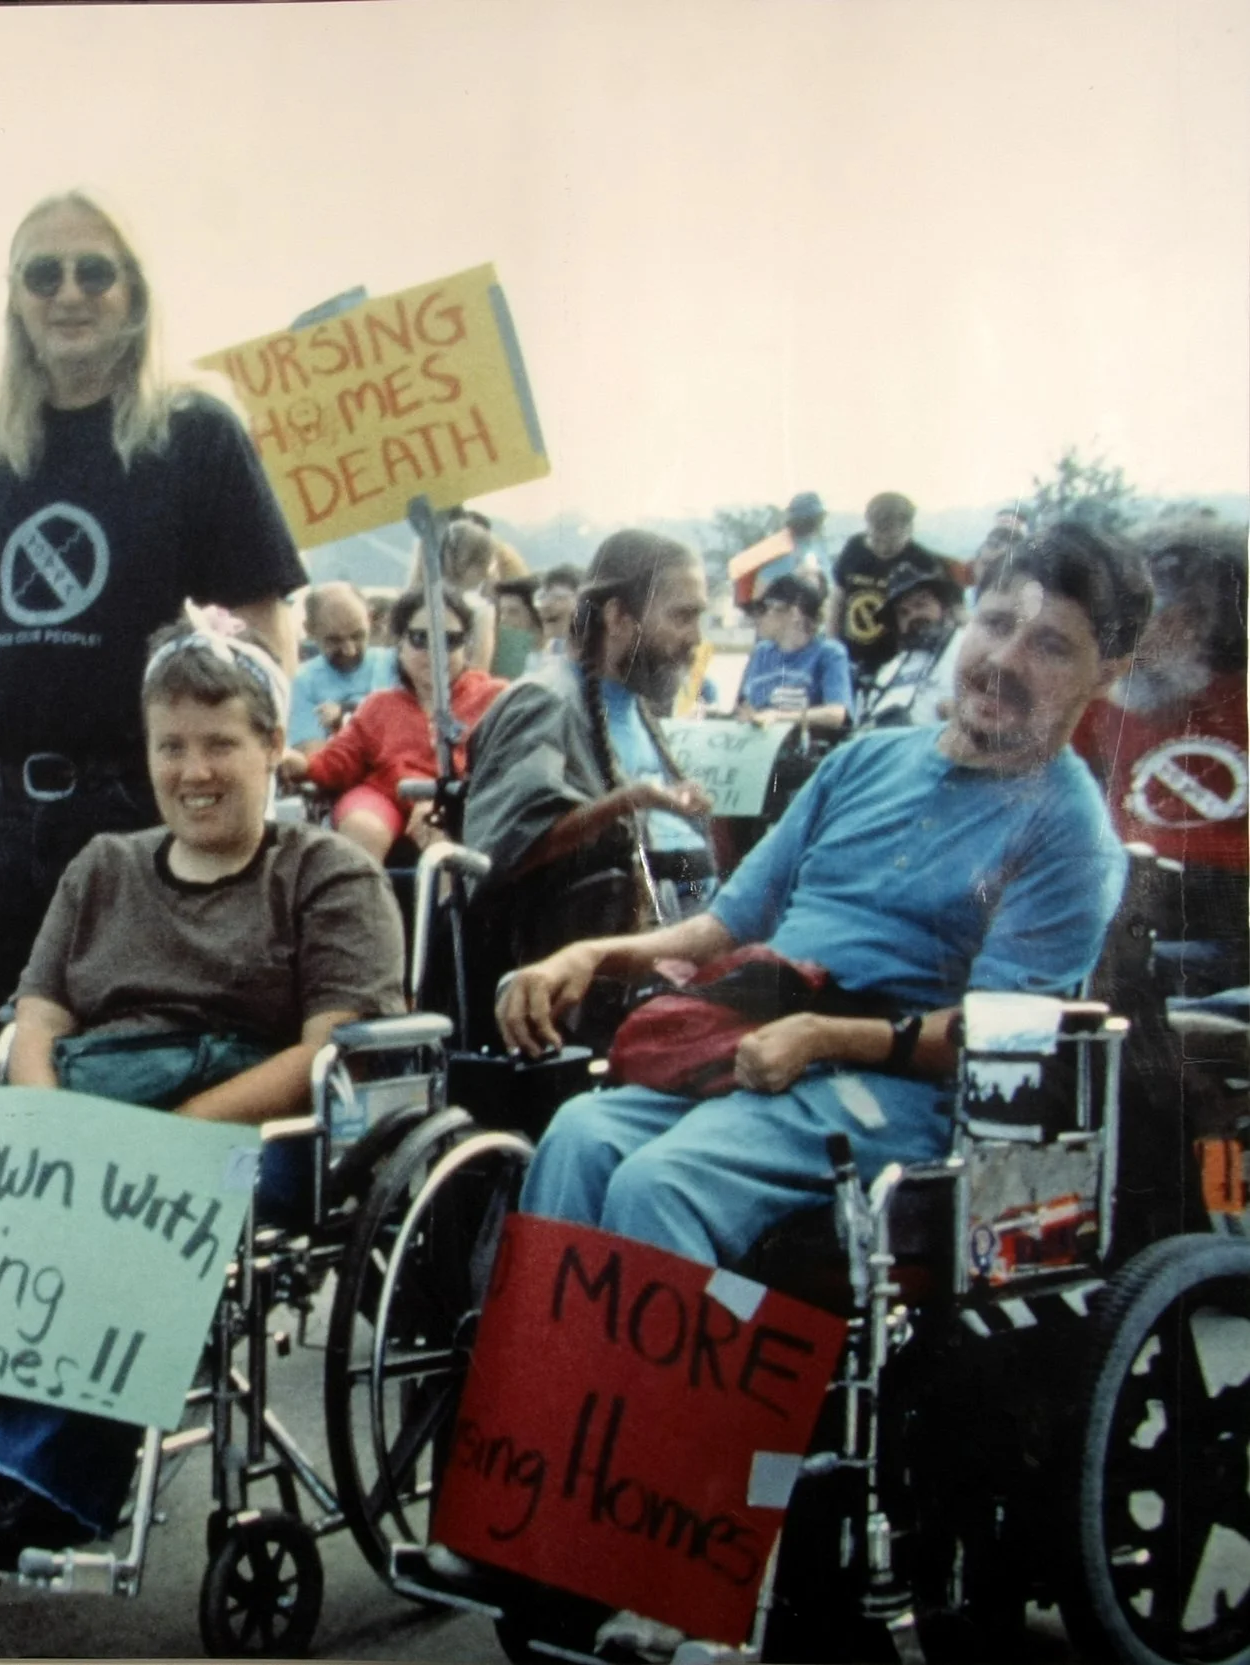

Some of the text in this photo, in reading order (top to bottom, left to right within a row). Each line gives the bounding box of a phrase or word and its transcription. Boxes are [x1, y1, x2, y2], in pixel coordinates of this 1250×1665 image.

[286, 403, 498, 526] DEATH
[100, 1162, 223, 1280] With
[552, 1243, 816, 1425] MORE
[562, 1390, 763, 1587] Homes
